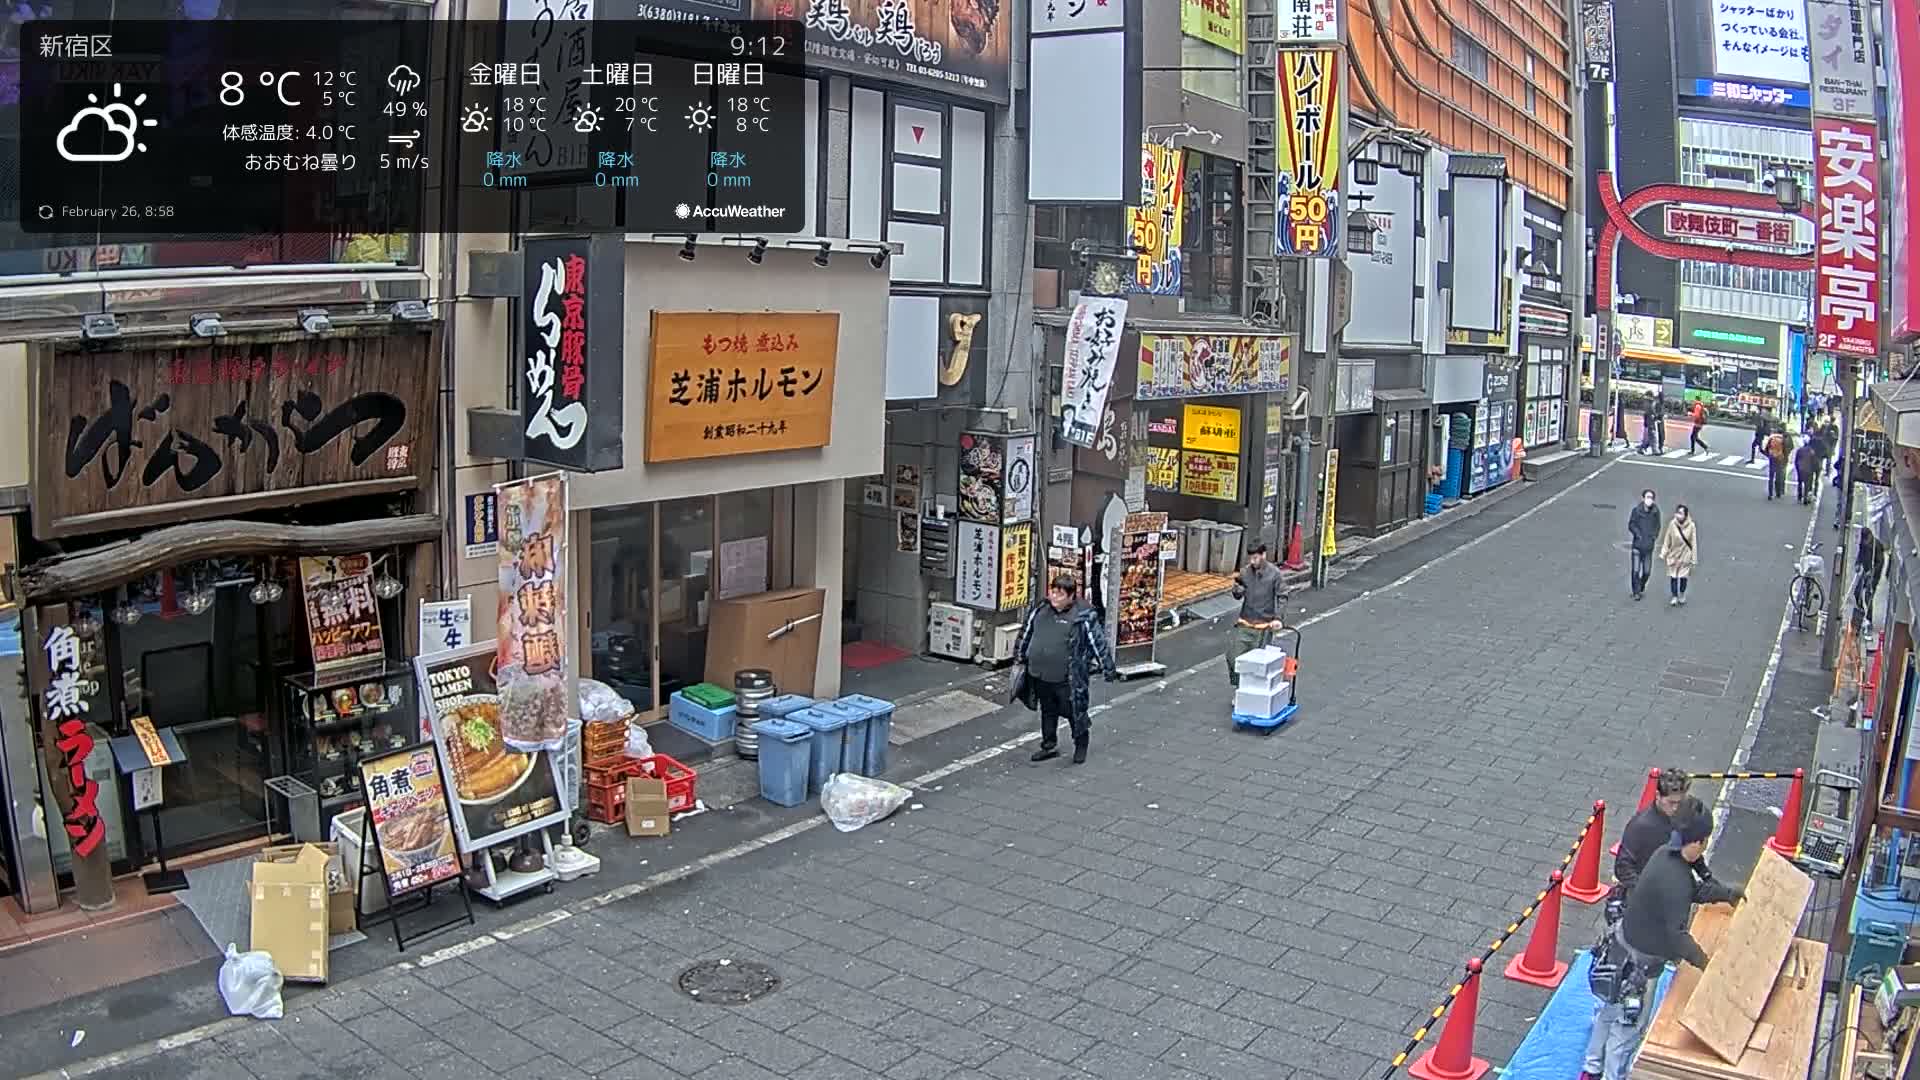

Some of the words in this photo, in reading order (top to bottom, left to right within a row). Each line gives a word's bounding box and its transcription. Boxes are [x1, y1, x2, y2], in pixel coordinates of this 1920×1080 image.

[1720, 3, 1794, 20] シャッターばかり
[1722, 40, 1799, 58] そんなイメージは
[1589, 64, 1610, 80] 7F
[1712, 81, 1792, 104] 三和シャッター
[1832, 98, 1856, 112] 3F
[1295, 54, 1321, 191] ハイボール
[1161, 152, 1175, 288] ハイボール
[1670, 211, 1790, 243] 歌舞伎町一番街
[1819, 127, 1875, 330] 安楽亭
[562, 254, 586, 401] 東京豚骨
[703, 333, 748, 355] もつ焼
[756, 332, 799, 353] 煮込み
[1818, 332, 1836, 348] 2F
[1080, 307, 1116, 410] お好み焼き
[669, 366, 823, 405] 芝浦ホルモン
[66, 379, 406, 491] ばんから
[973, 528, 984, 600] 芝浦ホルモン
[439, 608, 455, 628] 生
[429, 665, 471, 686] TOKYO
[432, 678, 473, 699] RAMEN
[435, 694, 465, 711] SHOP
[368, 768, 413, 801] 角煮
